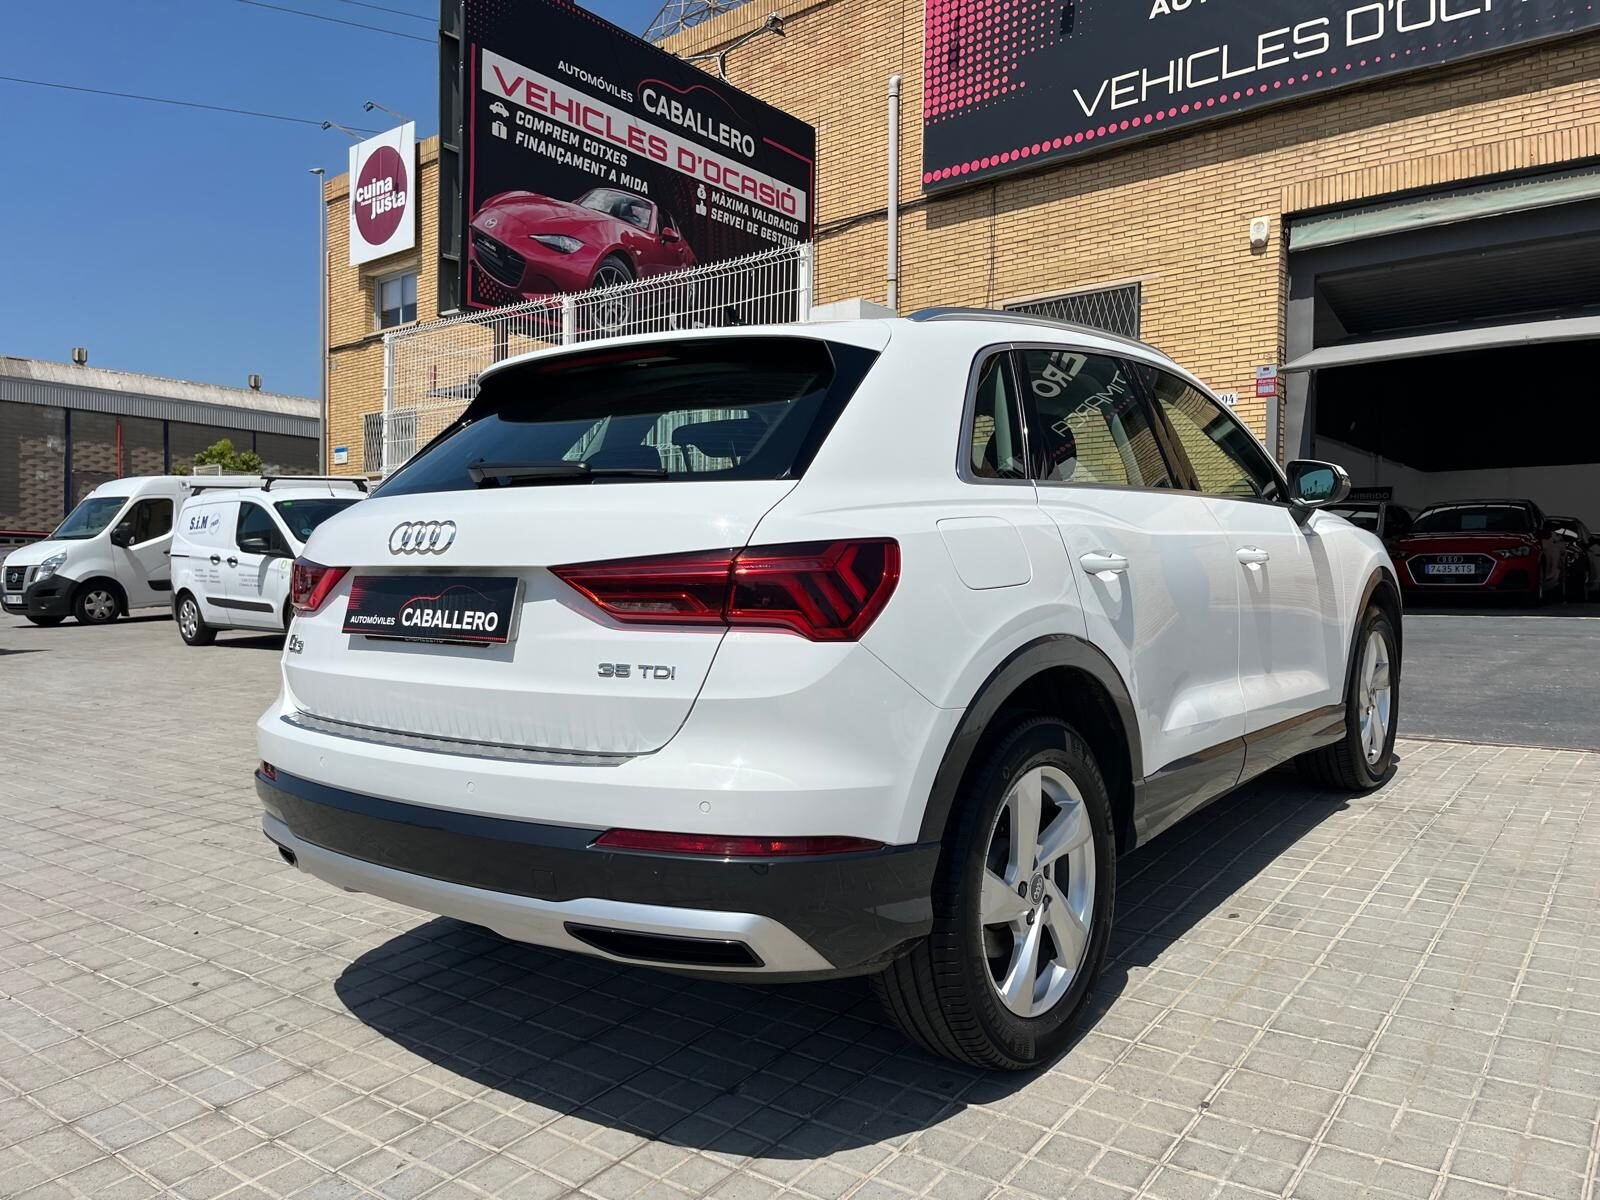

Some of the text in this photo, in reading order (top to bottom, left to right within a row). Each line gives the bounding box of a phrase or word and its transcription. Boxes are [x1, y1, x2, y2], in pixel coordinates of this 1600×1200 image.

[1073, 17, 1330, 117] VEHICLES
[558, 60, 755, 158] AUTOMÓVILES CABALLERO
[492, 64, 796, 216] VEHICLES D'OCASIÓ
[515, 110, 628, 167] COMPREM COTXES
[515, 131, 649, 195] FINANÇAMENT A MIDA
[356, 176, 393, 203] cuina
[370, 191, 406, 220] justa
[710, 208, 744, 230] SERVEI
[747, 221, 758, 235] DE
[752, 206, 799, 235] VALORACIÓ
[350, 607, 499, 632] AUTOMÓVILES CABALLERO
[597, 662, 676, 680] 35 TDI
